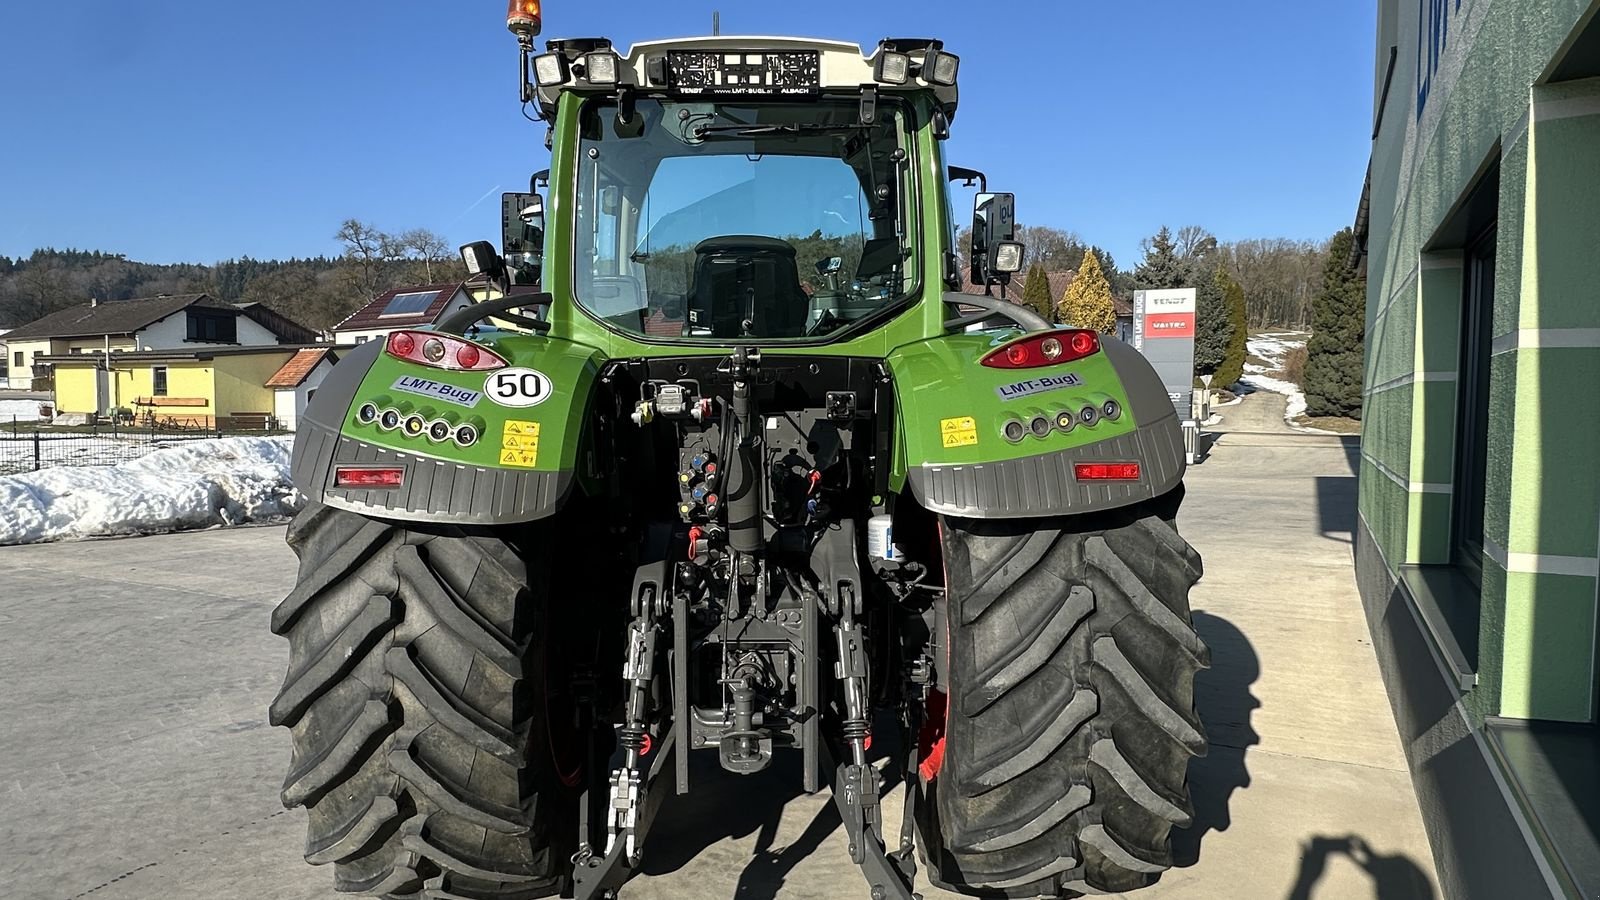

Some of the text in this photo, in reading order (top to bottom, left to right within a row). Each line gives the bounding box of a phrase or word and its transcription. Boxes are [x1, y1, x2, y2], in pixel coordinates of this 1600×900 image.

[400, 376, 479, 402] LMT-Bugl
[497, 374, 541, 398] 50
[1000, 373, 1078, 395] LMT-Bugl
